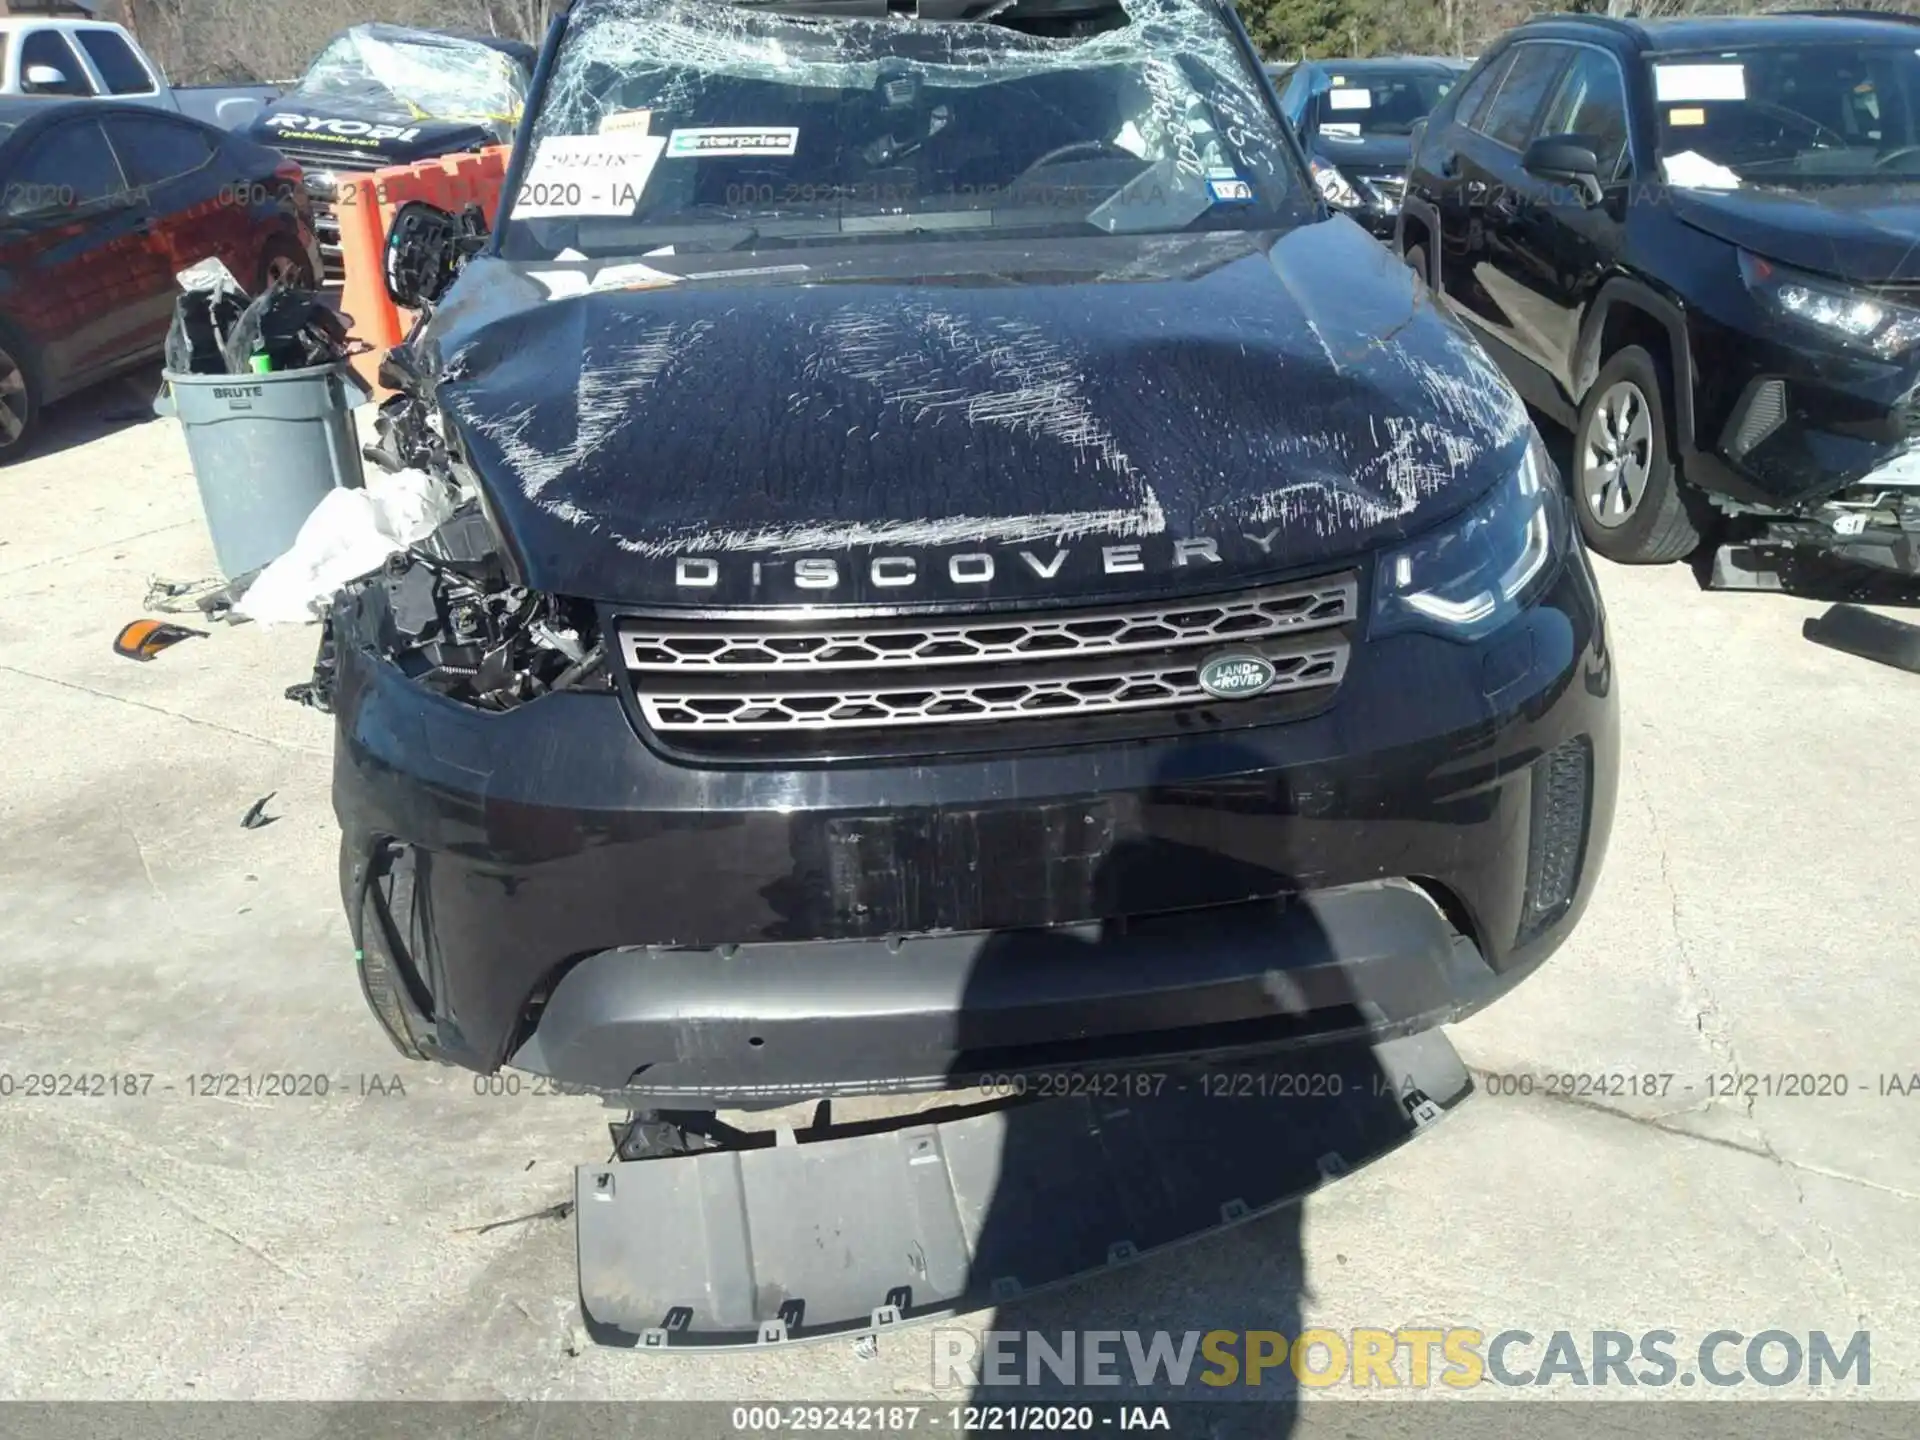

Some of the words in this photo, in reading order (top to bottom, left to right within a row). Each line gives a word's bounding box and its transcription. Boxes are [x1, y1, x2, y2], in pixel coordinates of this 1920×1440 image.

[265, 113, 421, 143] RYOBI
[675, 134, 790, 149] enterprise
[212, 386, 263, 399] BRUTE
[675, 528, 1281, 588] DISCOVERY
[1216, 663, 1251, 678] LAND
[1221, 673, 1263, 689] ROVER
